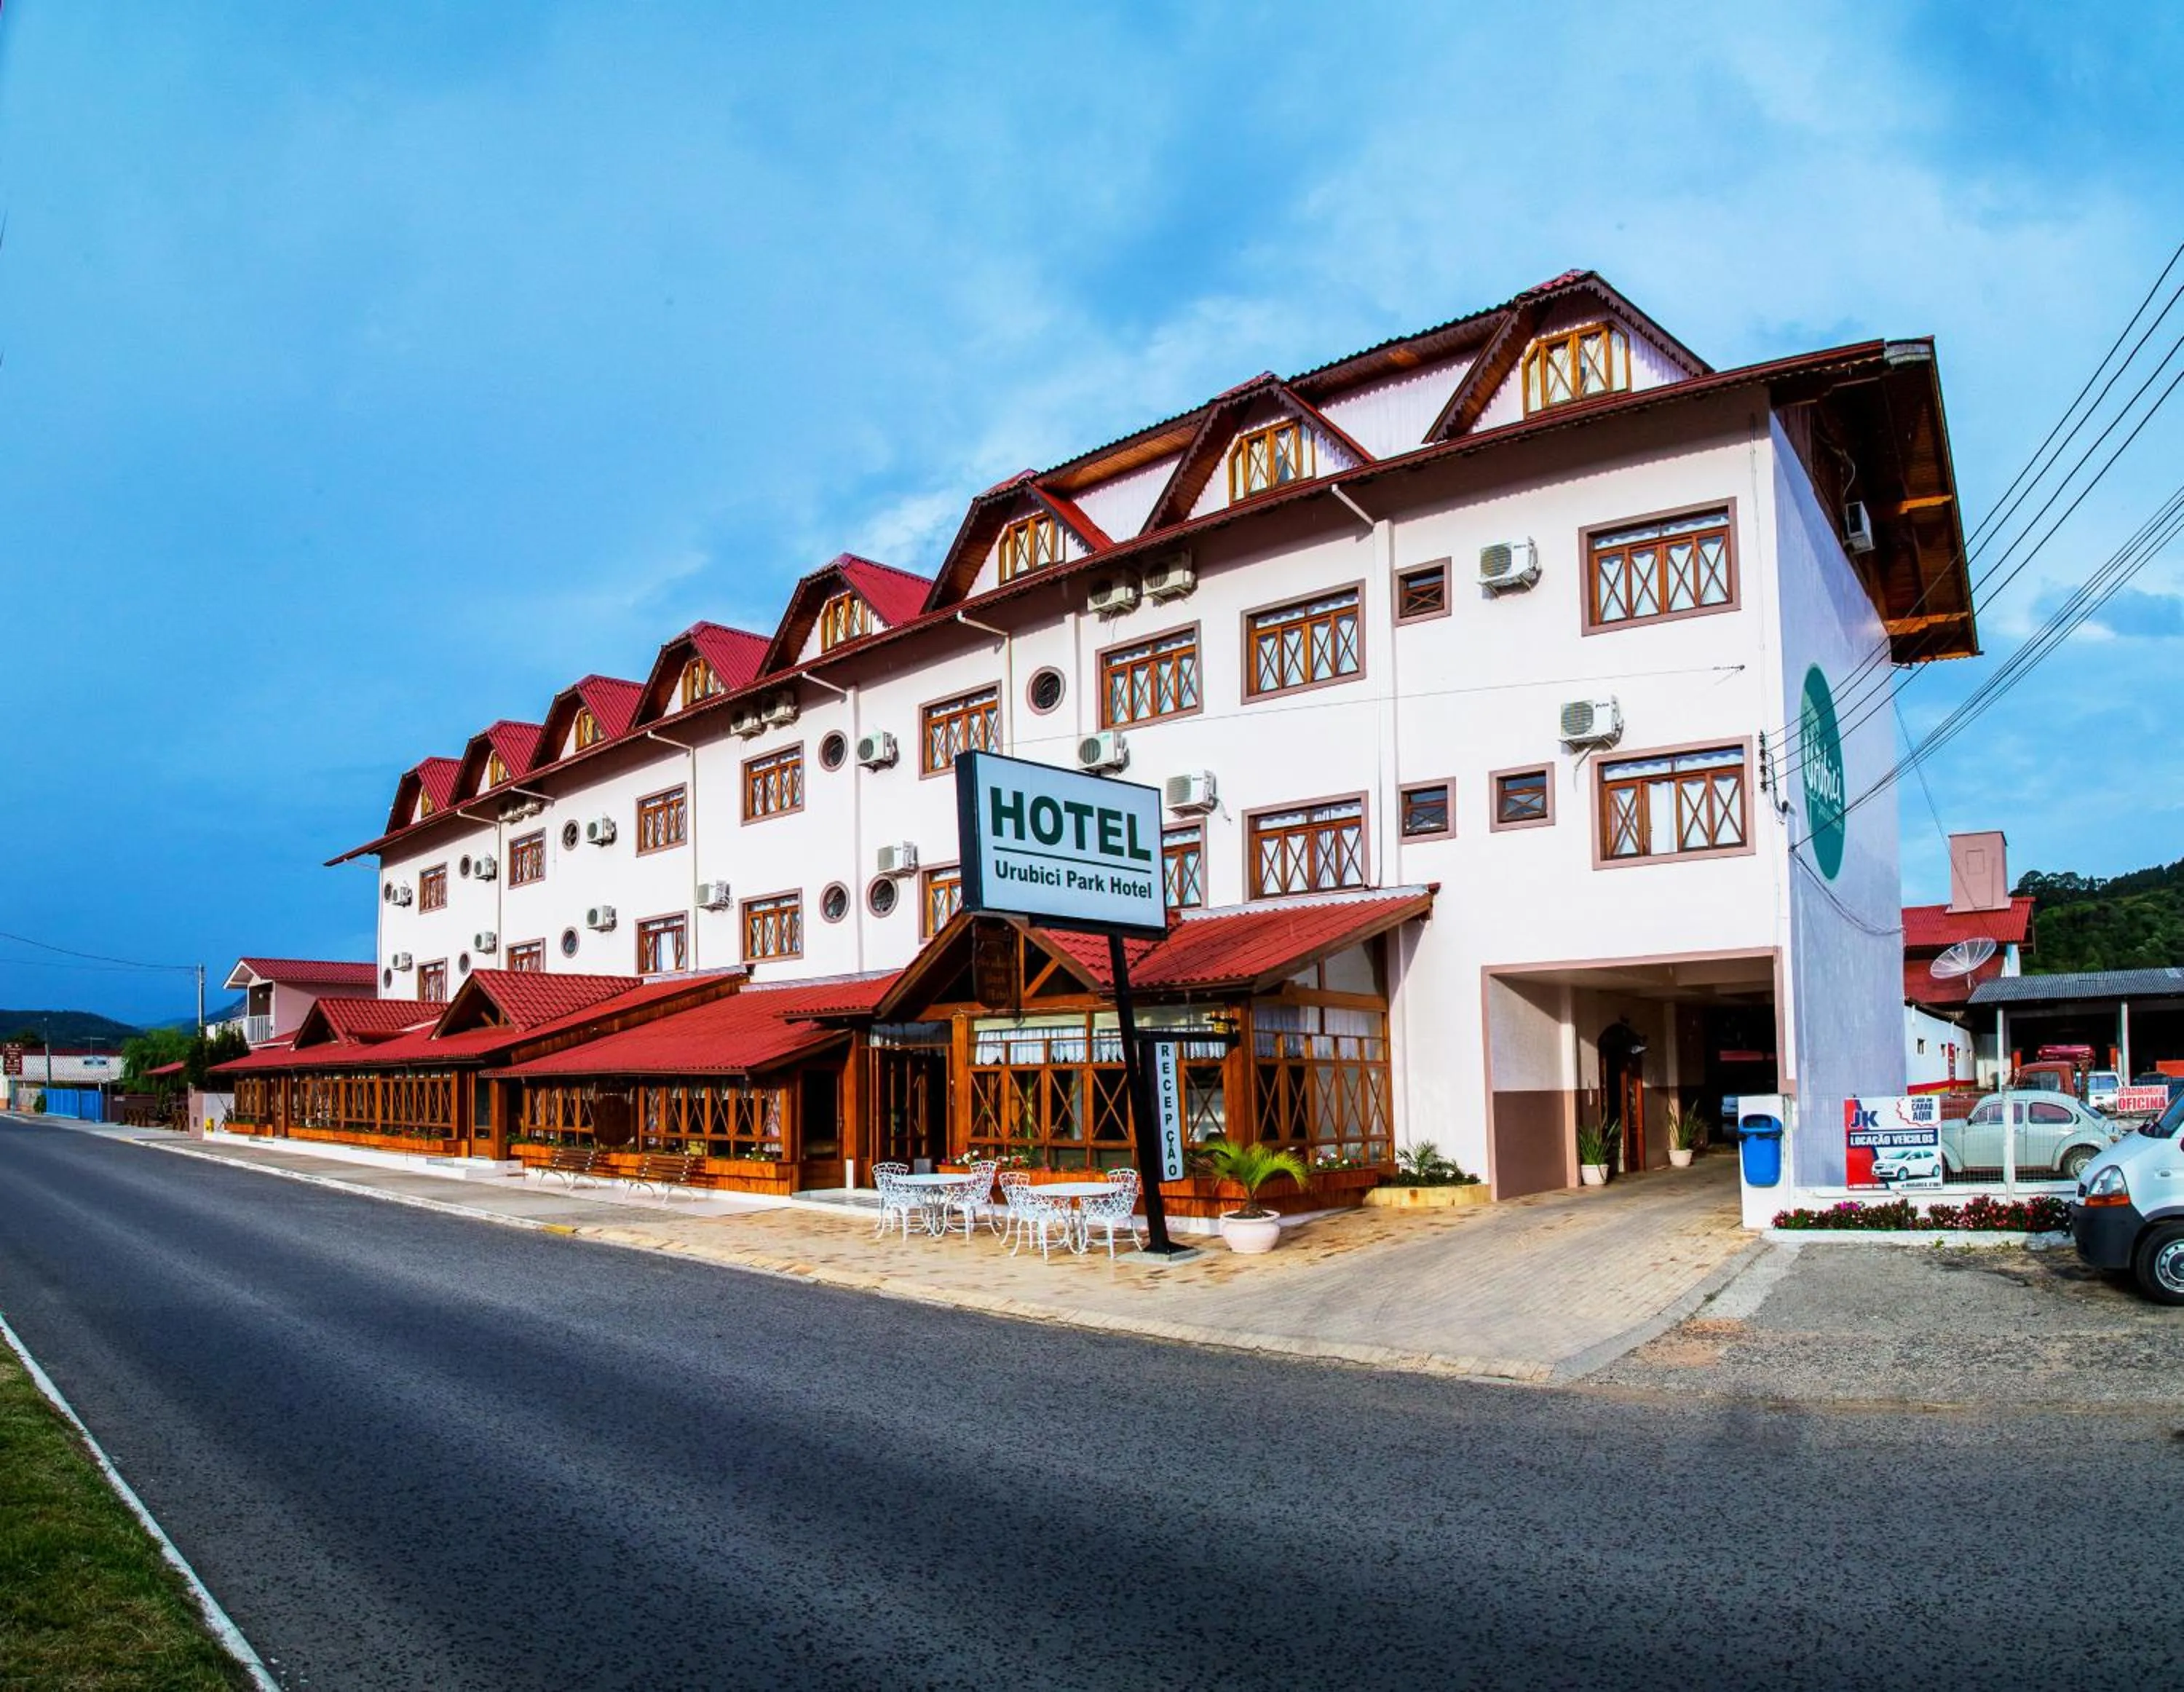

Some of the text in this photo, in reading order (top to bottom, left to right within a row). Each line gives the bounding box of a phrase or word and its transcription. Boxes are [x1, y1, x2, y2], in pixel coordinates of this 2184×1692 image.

[990, 786, 1152, 861] HOTEL
[995, 860, 1152, 898] Urubici Park Hotel
[1161, 1045, 1177, 1177] RECEPÇÃO
[2118, 1097, 2165, 1110] OFICINA
[1851, 1110, 1879, 1127] JK
[1850, 1134, 1891, 1146] LOCAÇÃO
